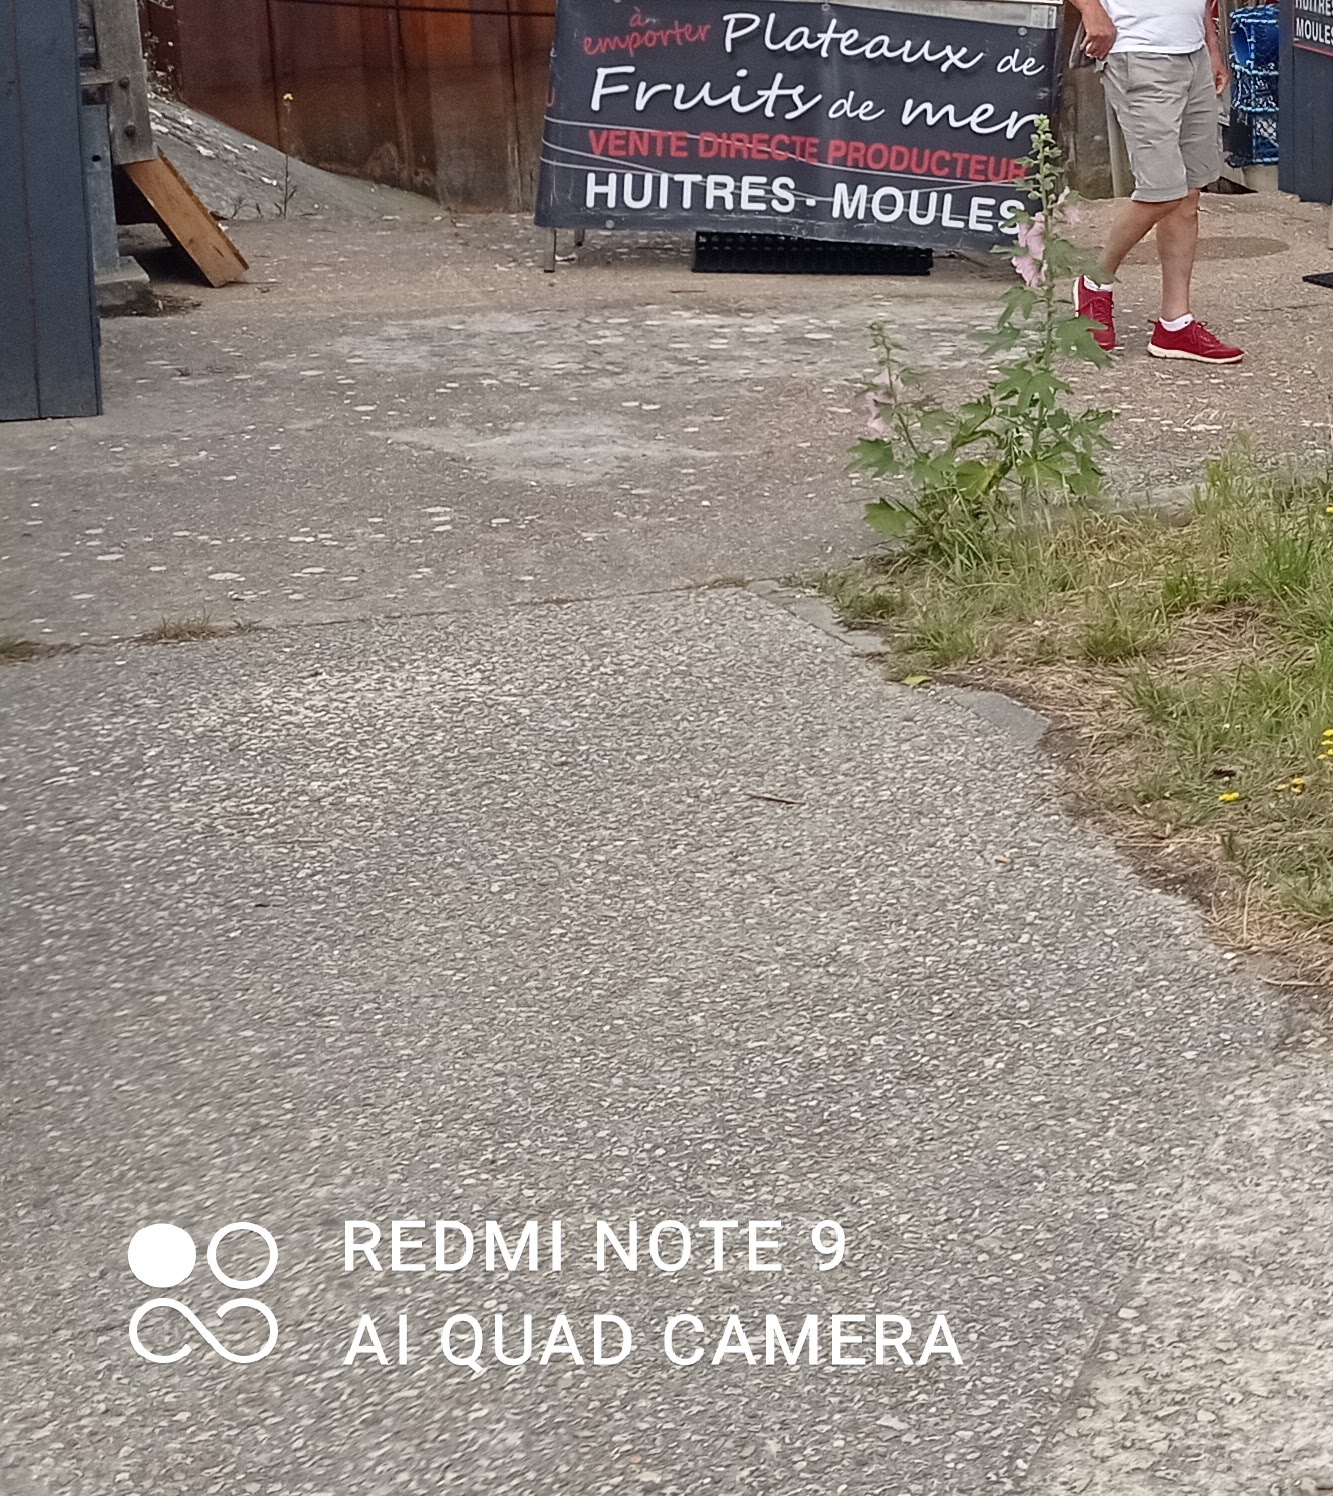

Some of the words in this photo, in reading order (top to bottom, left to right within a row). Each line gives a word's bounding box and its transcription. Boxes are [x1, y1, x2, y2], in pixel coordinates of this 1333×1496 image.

[583, 20, 711, 58] emporter
[723, 11, 983, 72] Plateaux
[997, 49, 1046, 78] de
[629, 6, 643, 28] à
[590, 66, 823, 120] Fruits
[828, 90, 884, 121] de
[902, 97, 1041, 141] mer
[589, 130, 689, 159] VENTE
[698, 132, 821, 164] DIRECTE
[827, 139, 1029, 183] PRODUCTEUR
[586, 172, 796, 213] HUITRES
[832, 183, 1027, 236] MOULES
